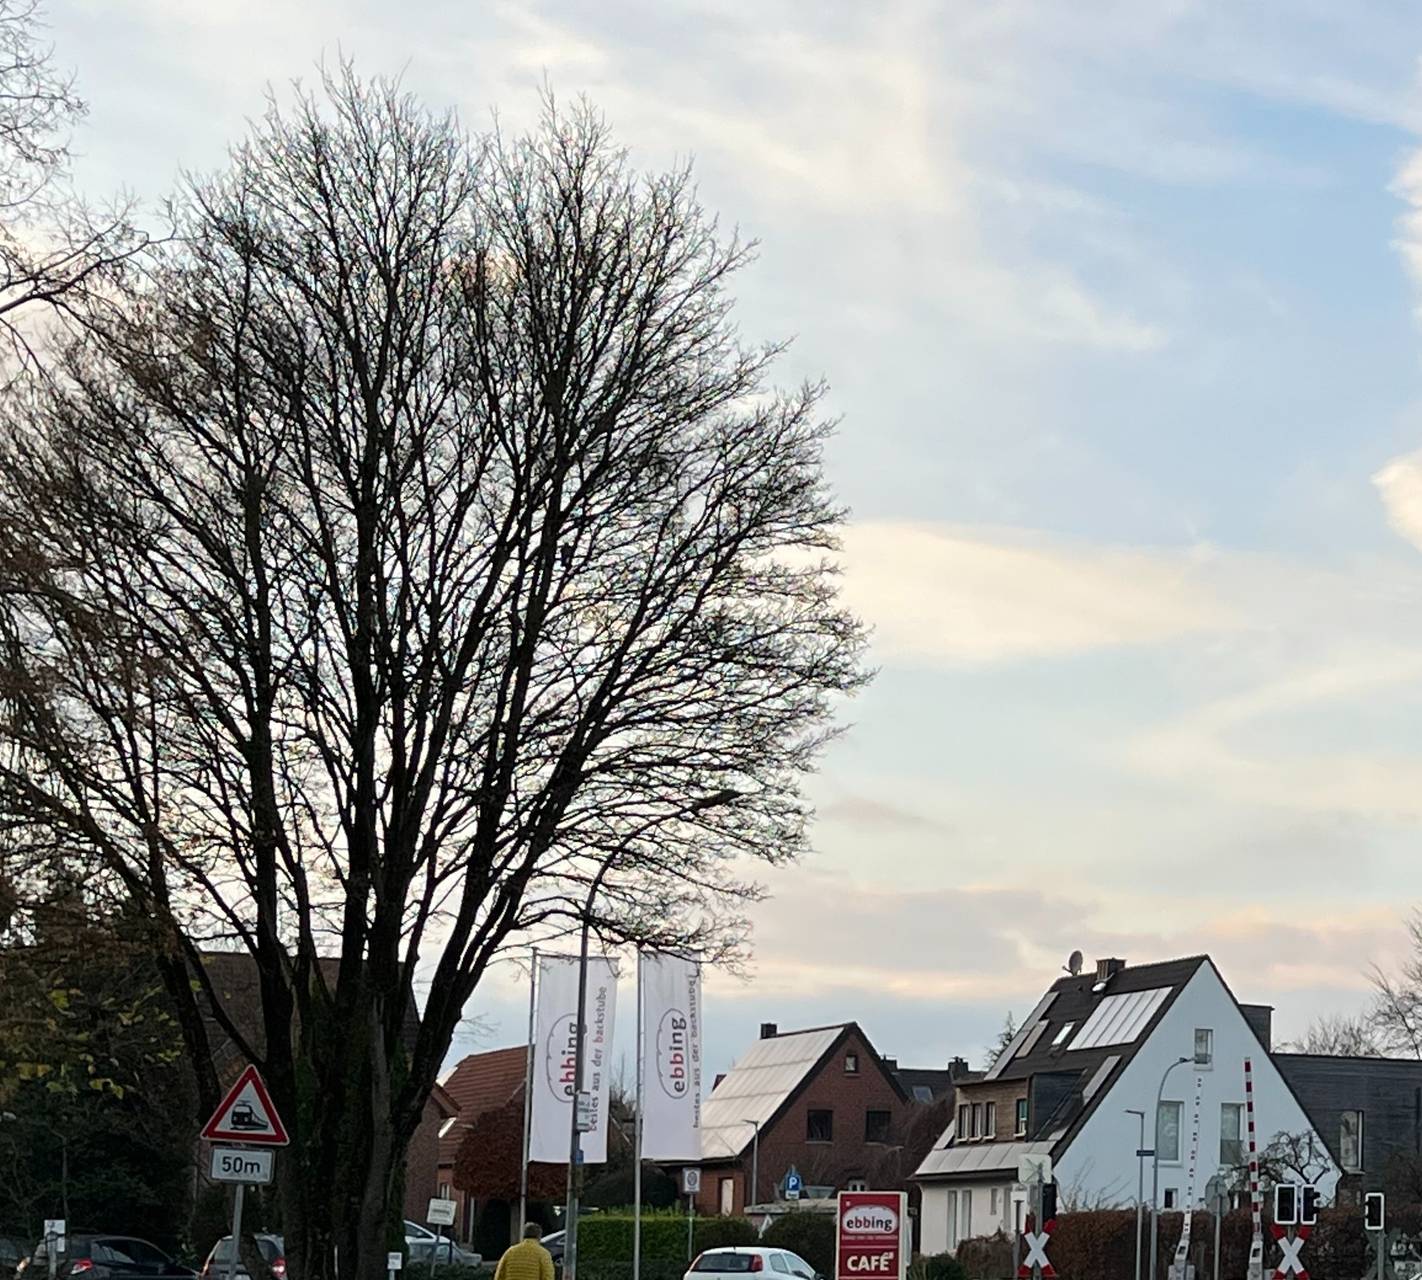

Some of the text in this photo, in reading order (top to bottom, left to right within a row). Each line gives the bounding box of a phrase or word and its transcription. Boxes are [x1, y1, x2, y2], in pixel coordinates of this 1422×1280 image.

[594, 987, 607, 1043] backstube
[591, 1051, 602, 1066] der
[669, 1017, 687, 1092] ebbing
[222, 1156, 260, 1173] 50m
[846, 1216, 892, 1232] ebbing
[847, 1252, 890, 1271] CAFÉ
